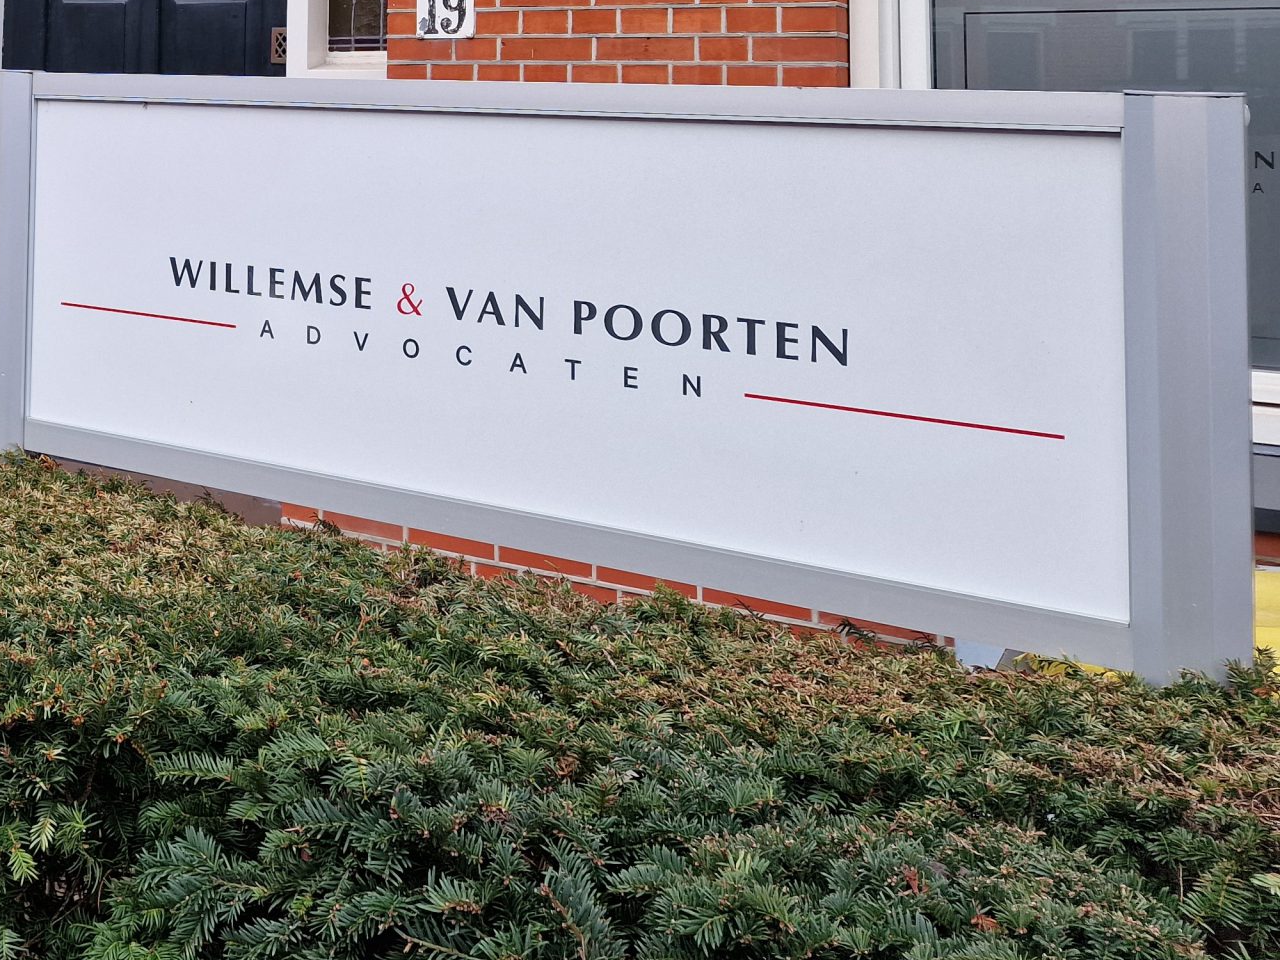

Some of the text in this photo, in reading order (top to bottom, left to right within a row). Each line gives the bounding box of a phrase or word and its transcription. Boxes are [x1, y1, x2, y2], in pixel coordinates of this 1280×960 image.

[169, 256, 848, 367] WILLEMSE & VAN POORTEN
[259, 319, 701, 398] ADVOCATEN
